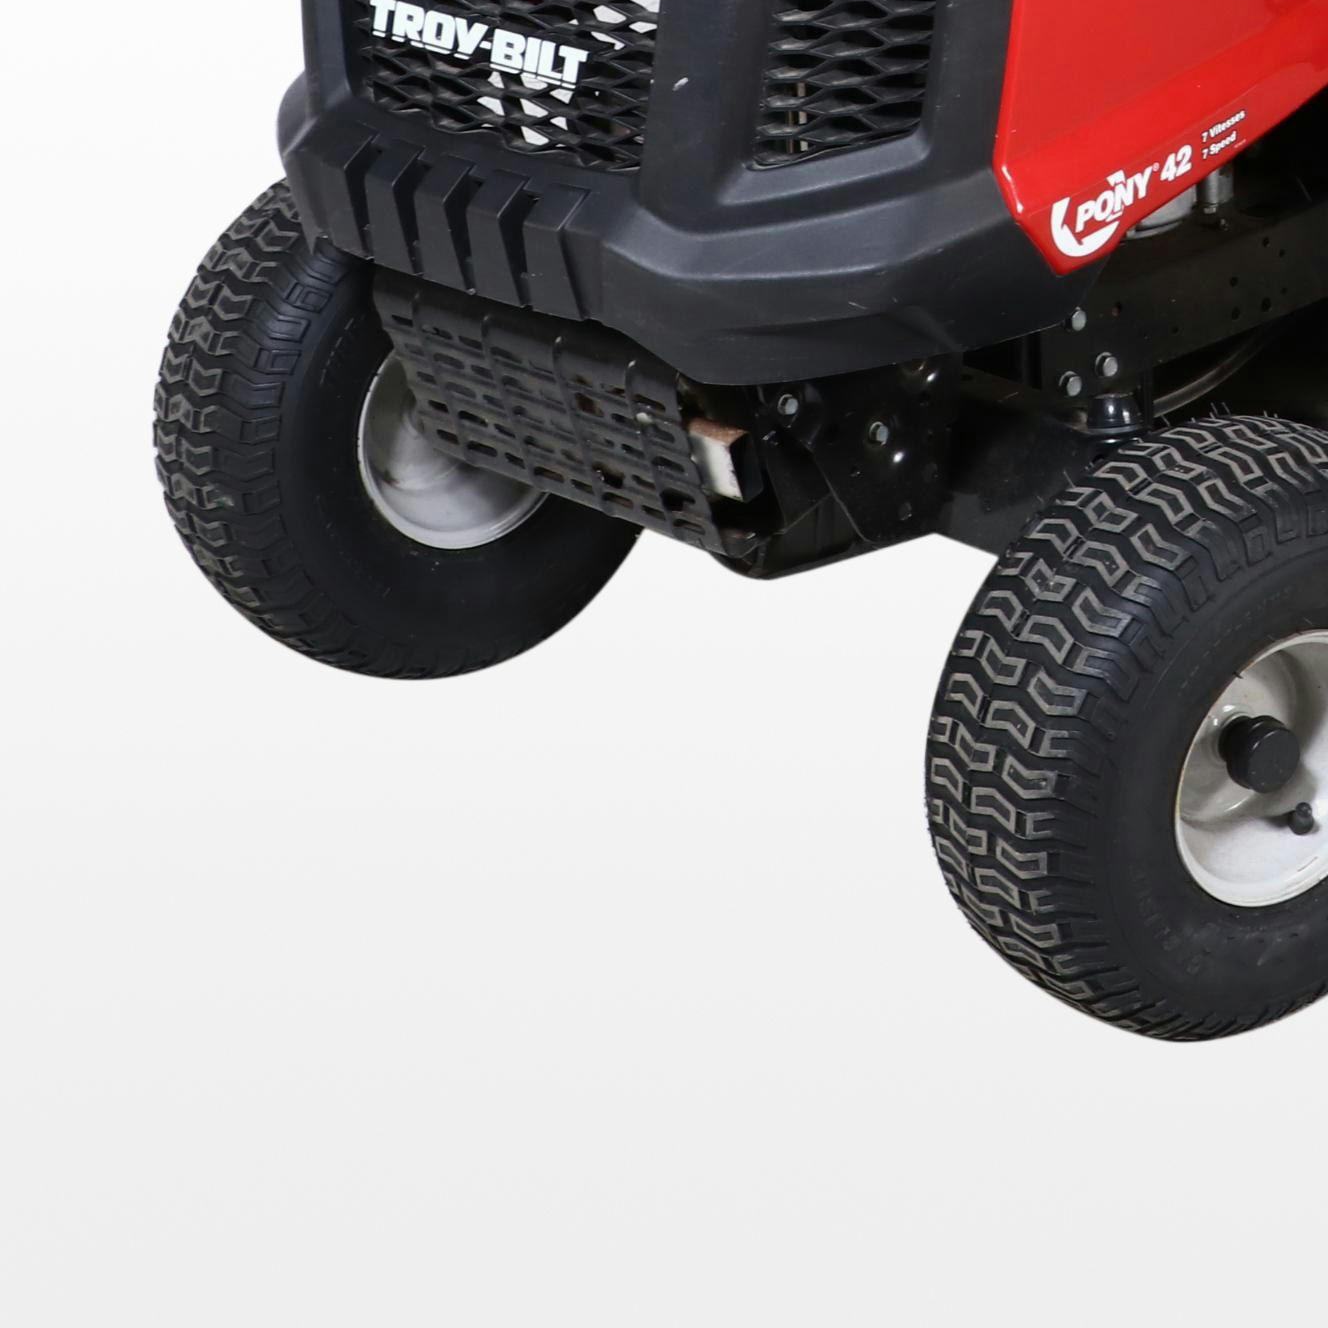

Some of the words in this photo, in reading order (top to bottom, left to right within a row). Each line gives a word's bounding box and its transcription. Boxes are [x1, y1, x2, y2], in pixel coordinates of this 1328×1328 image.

[1201, 131, 1209, 142] 7
[1209, 110, 1245, 137] Vitesses
[1201, 148, 1209, 159] 7
[1209, 130, 1237, 155] Speed
[1160, 144, 1193, 182] 42
